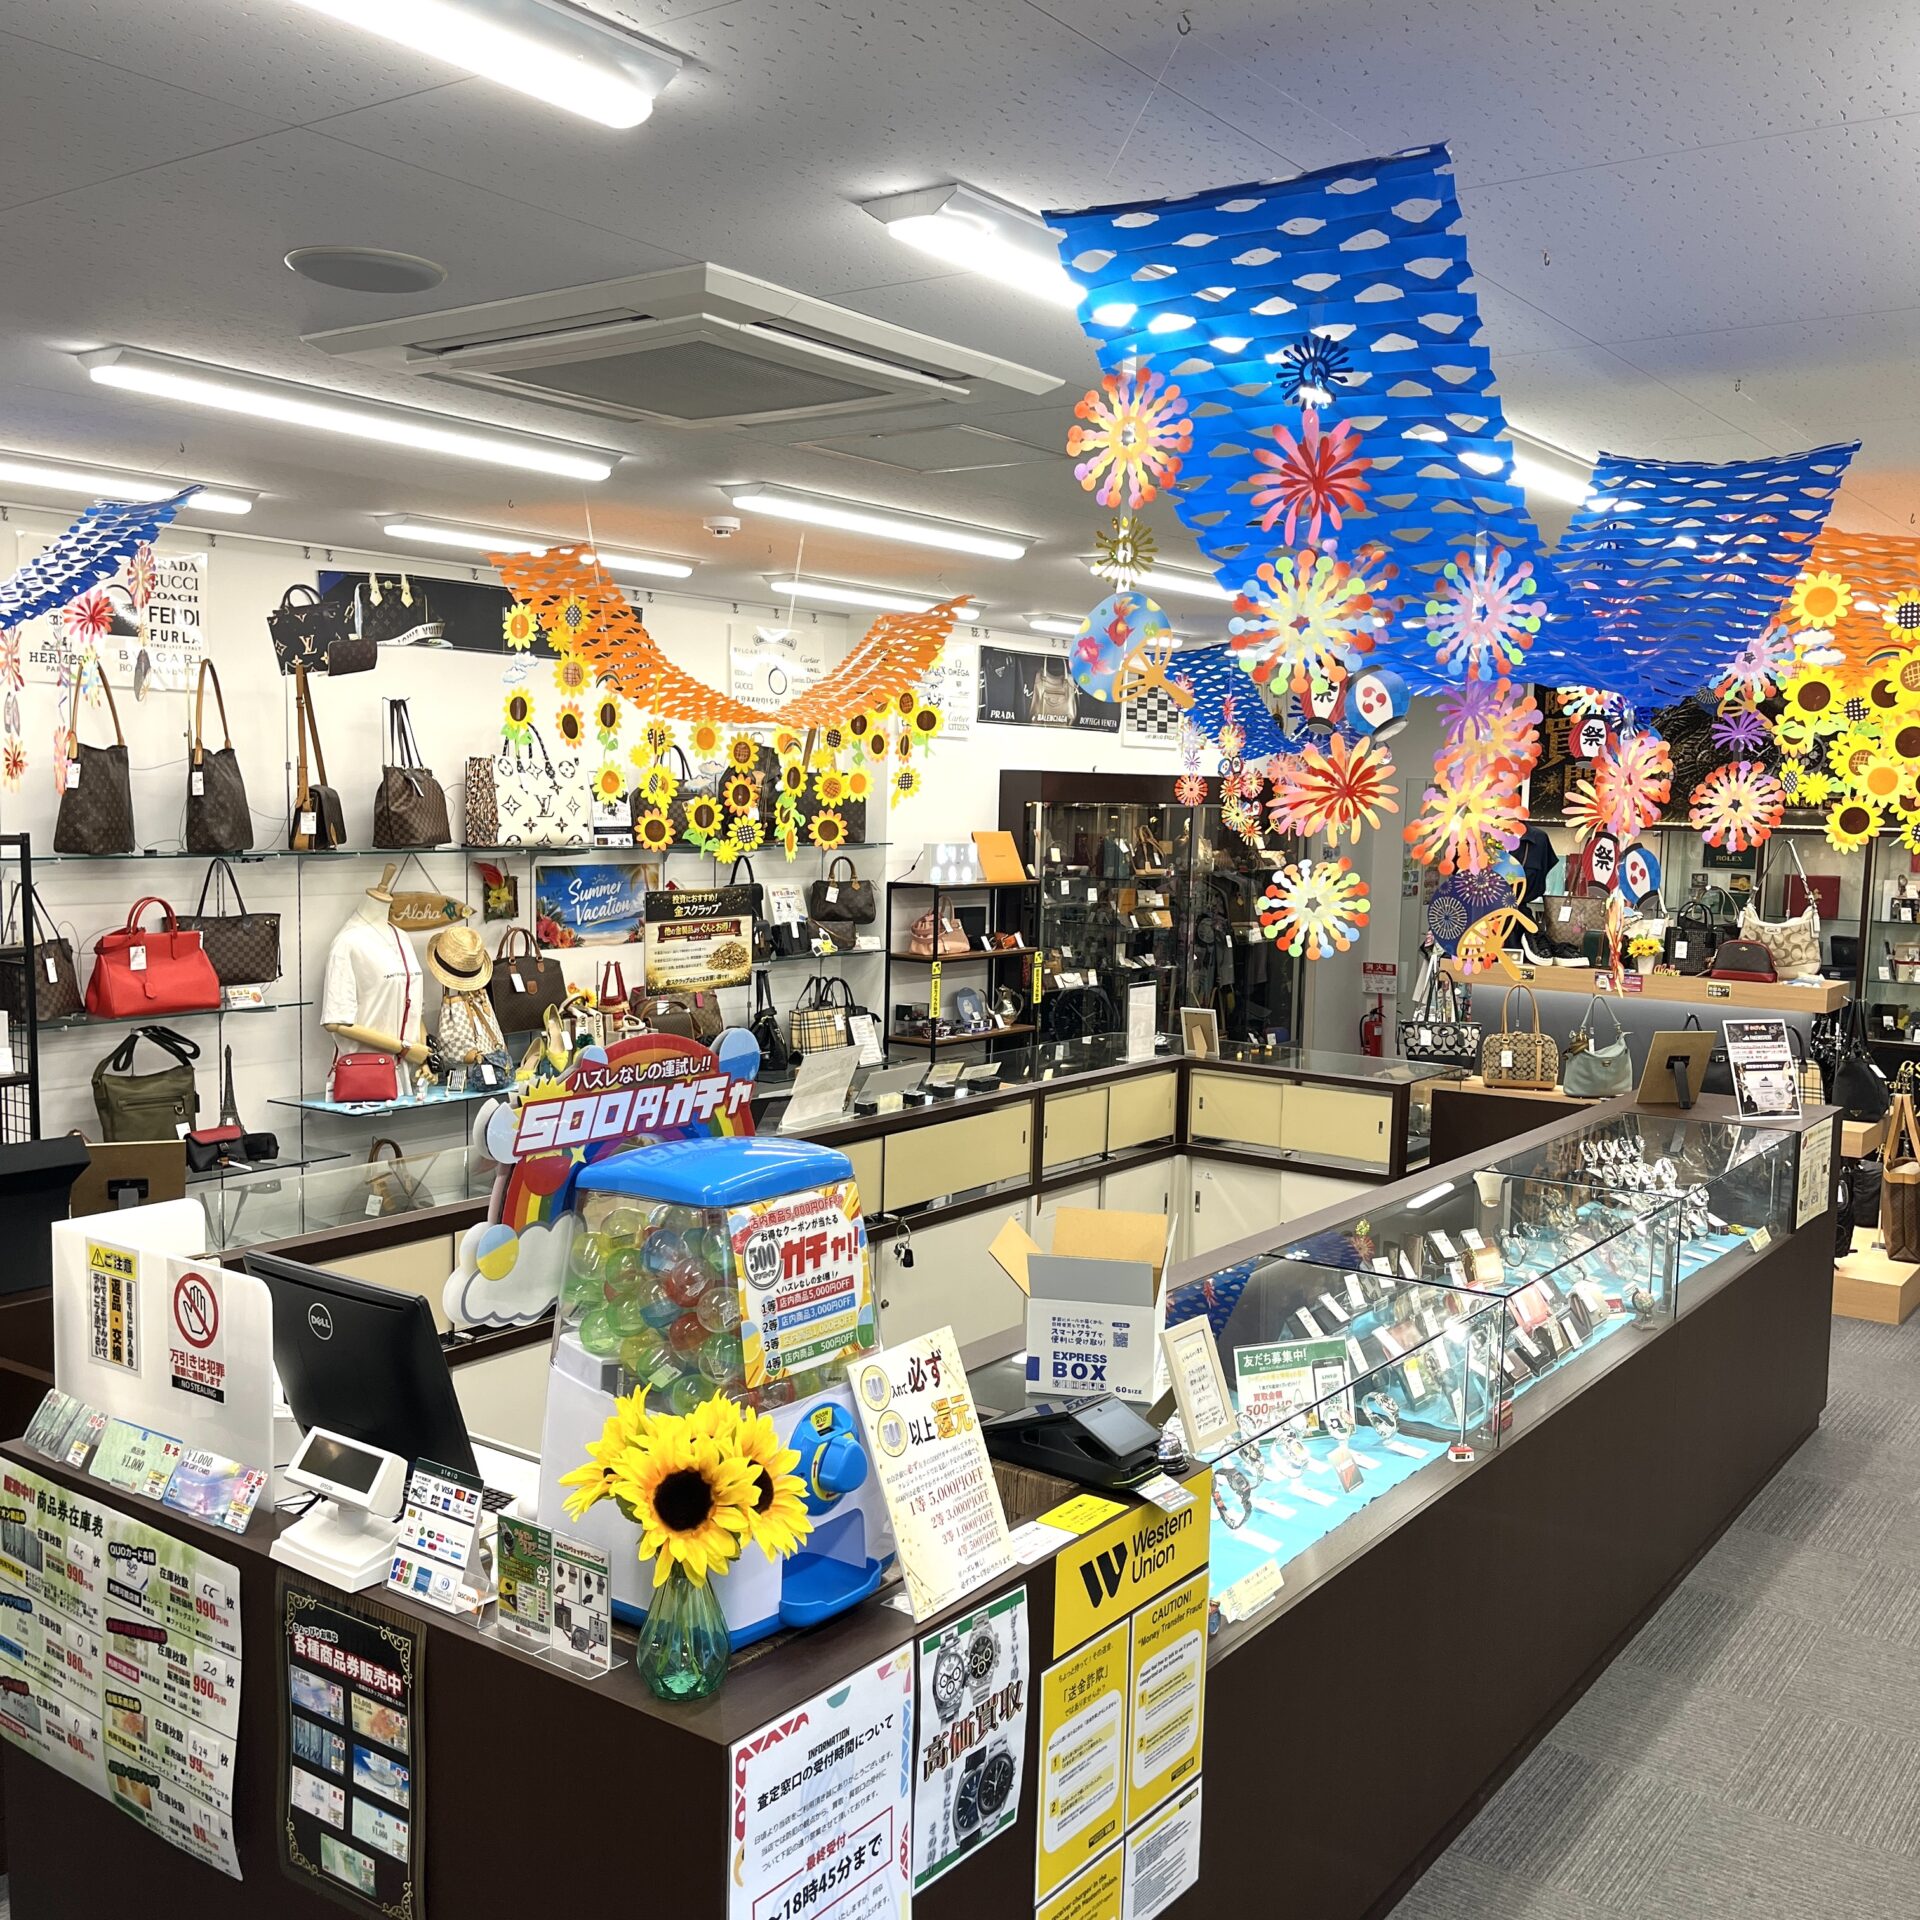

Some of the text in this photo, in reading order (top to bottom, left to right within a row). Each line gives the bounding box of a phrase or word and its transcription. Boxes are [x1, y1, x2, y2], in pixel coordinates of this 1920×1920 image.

[157, 560, 198, 573] RADA
[148, 592, 199, 603] COACH
[990, 709, 1016, 720] PRADA
[1582, 725, 1605, 747] 祭
[1594, 845, 1614, 872] 祭
[567, 878, 624, 905] Summer
[392, 903, 441, 920] Aloha
[575, 896, 632, 926] Vacation
[674, 902, 722, 917] 金スクラップ
[573, 1055, 712, 1092] ハズレなしの運試し!!
[515, 1075, 753, 1153] 500円ガチャ
[760, 1214, 839, 1242] お得なクーポンが当たる
[104, 1253, 132, 1274] ご注意
[750, 1226, 859, 1281] 500 ガチャ!!
[762, 1279, 850, 1315] 1等 店内商品5,000円OFF
[311, 1314, 331, 1329] DELL
[763, 1296, 852, 1333] 2等 店内商品3,000円OFF
[764, 1337, 779, 1352] 3等
[766, 1331, 855, 1371] 4等 店内商品 500円OFF
[1051, 1335, 1106, 1347] 便利に受け取り!
[170, 1349, 225, 1378] 万引きは犯罪
[1053, 1351, 1107, 1364] EXPRESS
[1243, 1347, 1307, 1368] 友だち募集中!
[1053, 1361, 1107, 1382] BOX
[181, 1379, 217, 1399] NO STEALING
[1253, 1390, 1283, 1402] 買取金額
[163, 1443, 180, 1457] 見本
[245, 1471, 265, 1487] 見本
[441, 1485, 454, 1496] VISA
[37, 1489, 104, 1539] 商品券在庫表
[1132, 1508, 1192, 1557] Western
[1132, 1543, 1175, 1584] Union
[159, 1566, 235, 1610] 在庫枚数 枚
[1151, 1590, 1192, 1625] CAUTION!
[1161, 1612, 1185, 1633] Transfer
[77, 1635, 84, 1648] 0
[157, 1645, 235, 1689] 在庫枚数 20 枚
[294, 1633, 402, 1696] 各種商品券販売中
[73, 1718, 80, 1733] 0
[922, 1680, 1024, 1782] 高価買取
[155, 1719, 229, 1768] 在庫枚数 枚
[807, 1726, 850, 1761] INFORMATION
[757, 1714, 894, 1812] 査定窓口の受付時間について
[157, 1790, 185, 1814] 在庫枚数
[805, 1831, 847, 1872] 最終受付
